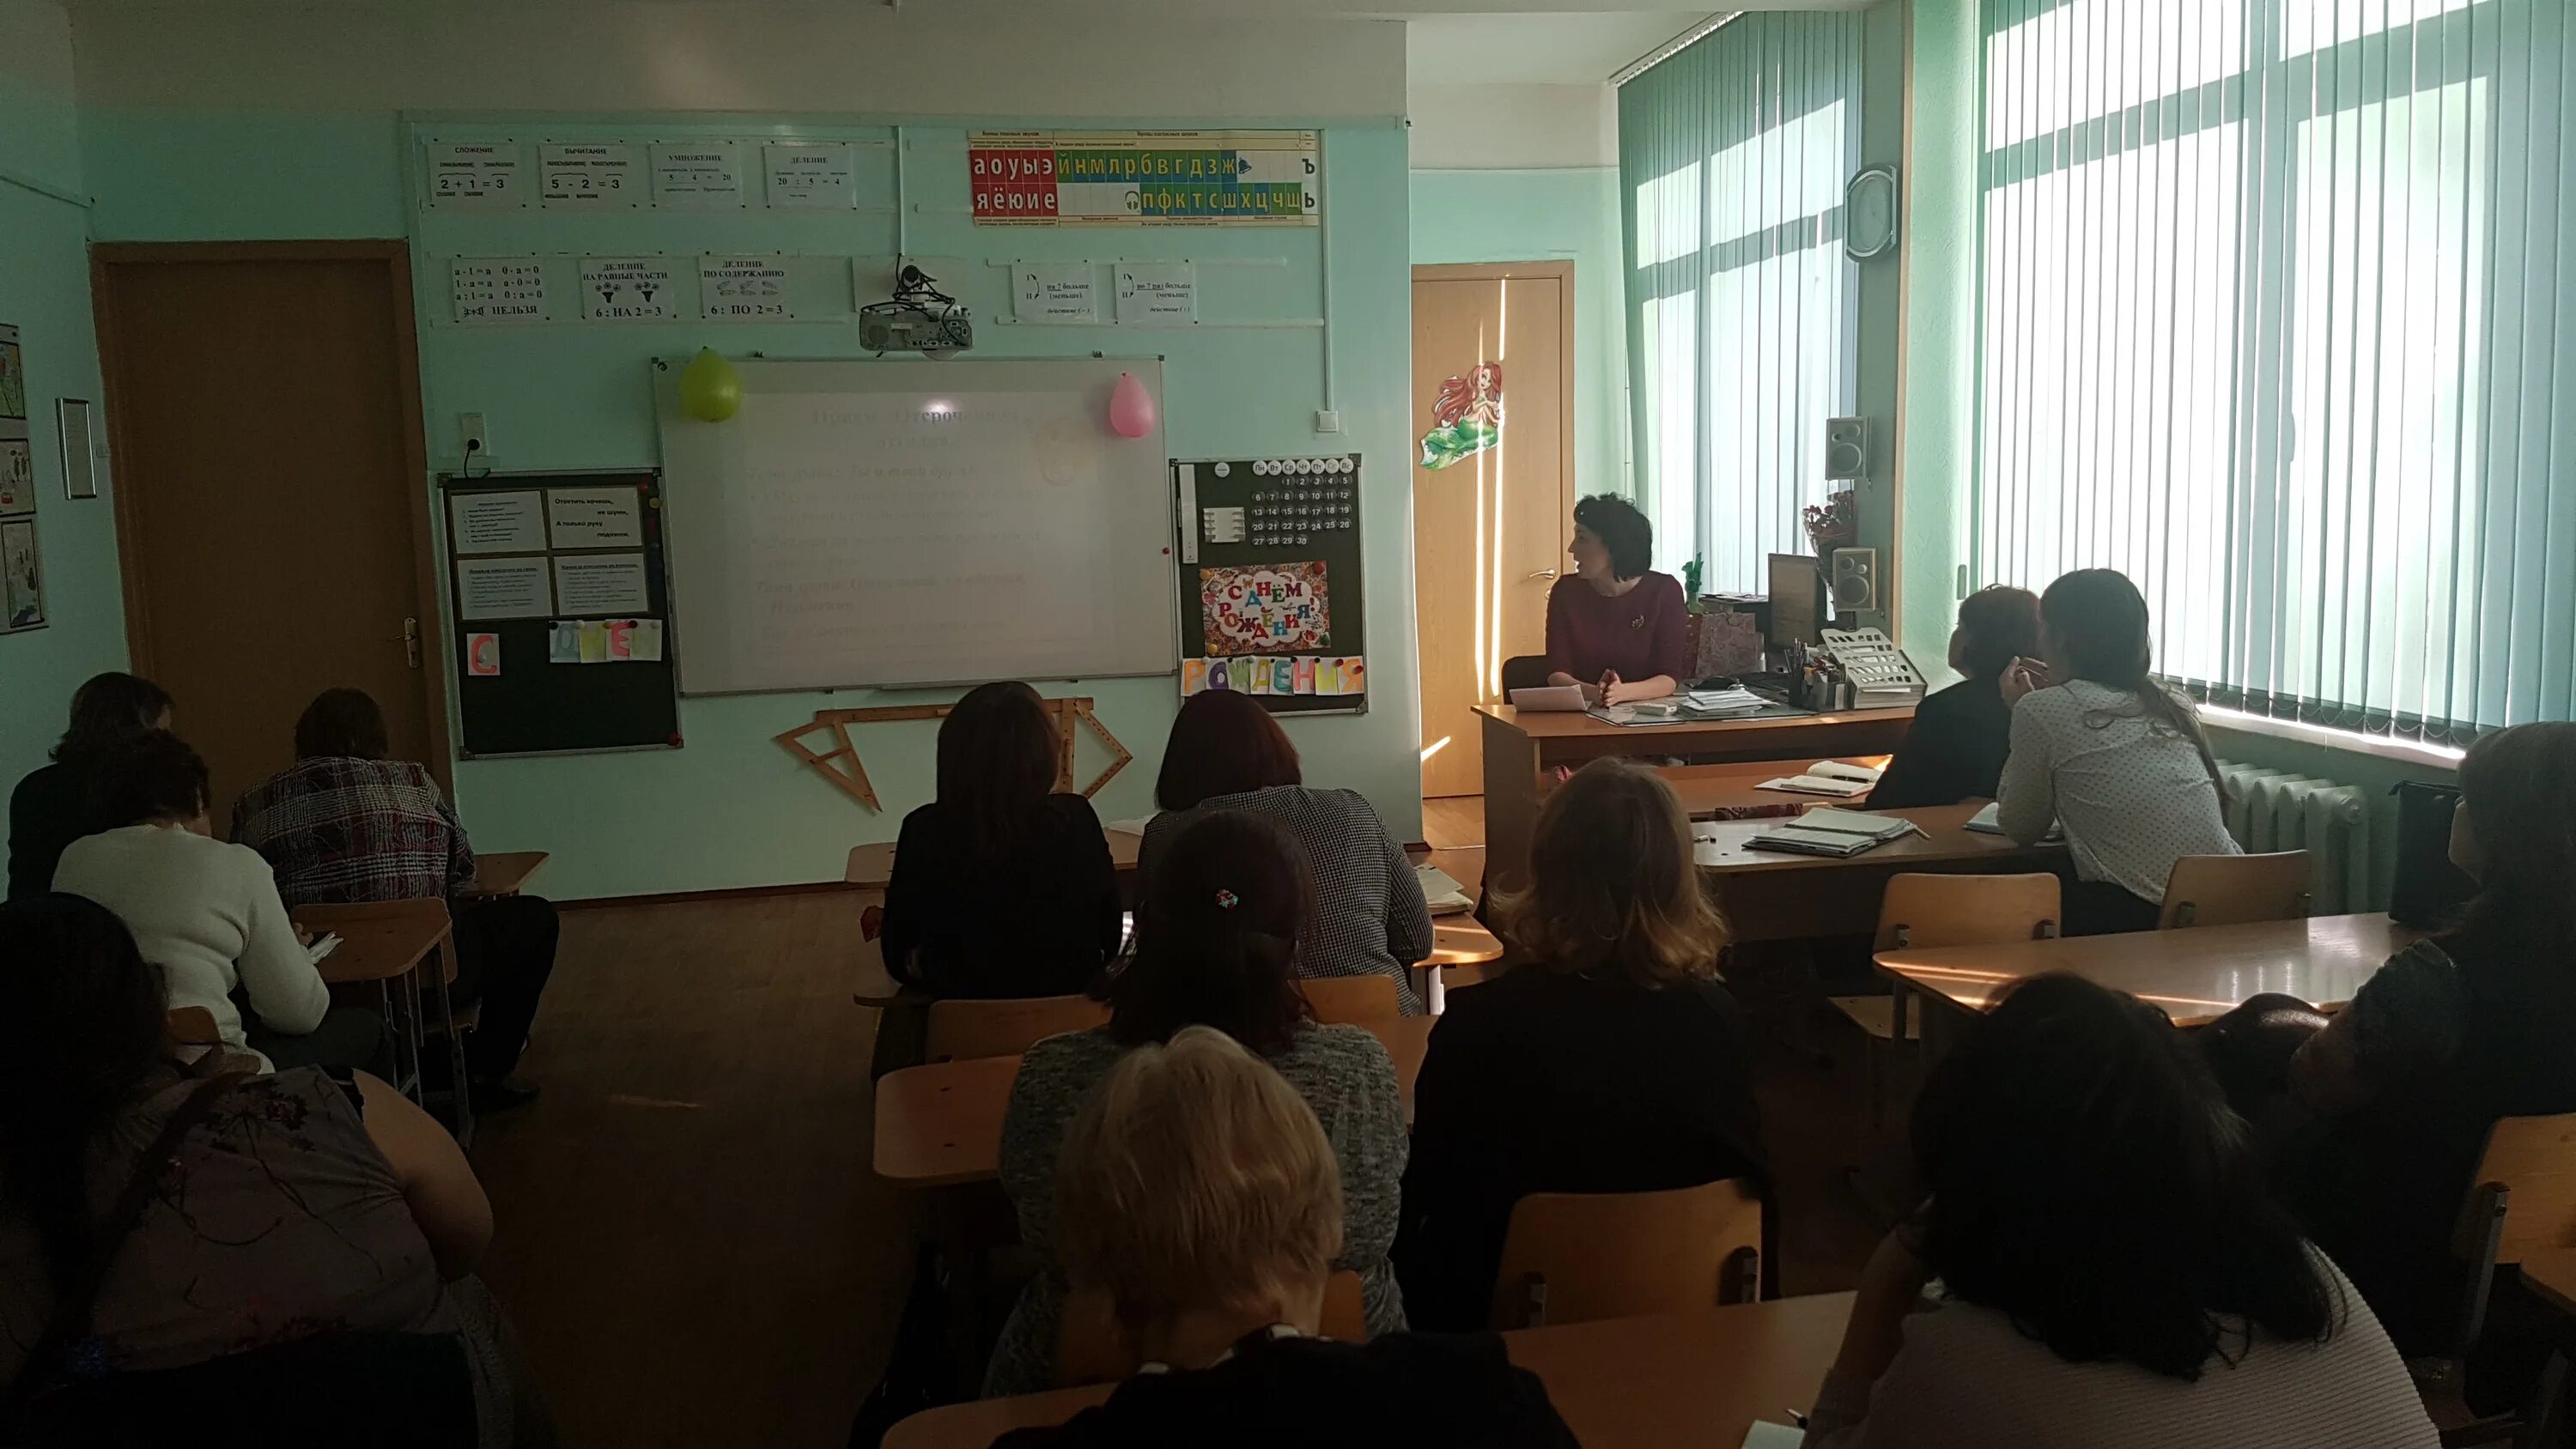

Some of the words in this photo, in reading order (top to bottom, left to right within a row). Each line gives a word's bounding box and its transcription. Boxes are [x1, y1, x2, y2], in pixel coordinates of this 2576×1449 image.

[455, 145, 494, 155] СЛОЖЕНИЕ
[565, 147, 606, 155] ВЫЧИТАНИЕ
[668, 154, 722, 163] УМНОЖЕНИЕ
[440, 179, 449, 189] 2
[496, 179, 504, 189] 3
[551, 179, 560, 189] 5
[581, 179, 590, 189] 2
[611, 179, 620, 189] 3
[604, 263, 646, 271] ДЕЛЕНИЕ
[722, 260, 764, 269] ДЕЛЕНИЕ
[636, 271, 668, 280] ЧАСТИ
[703, 270, 718, 278] ПО
[719, 270, 785, 278] СОДЕРЖАНИЮ
[492, 305, 538, 315] НЕЛЬЗЯ
[613, 307, 632, 318] НА
[731, 305, 750, 315] ПО
[1228, 585, 1242, 600] С
